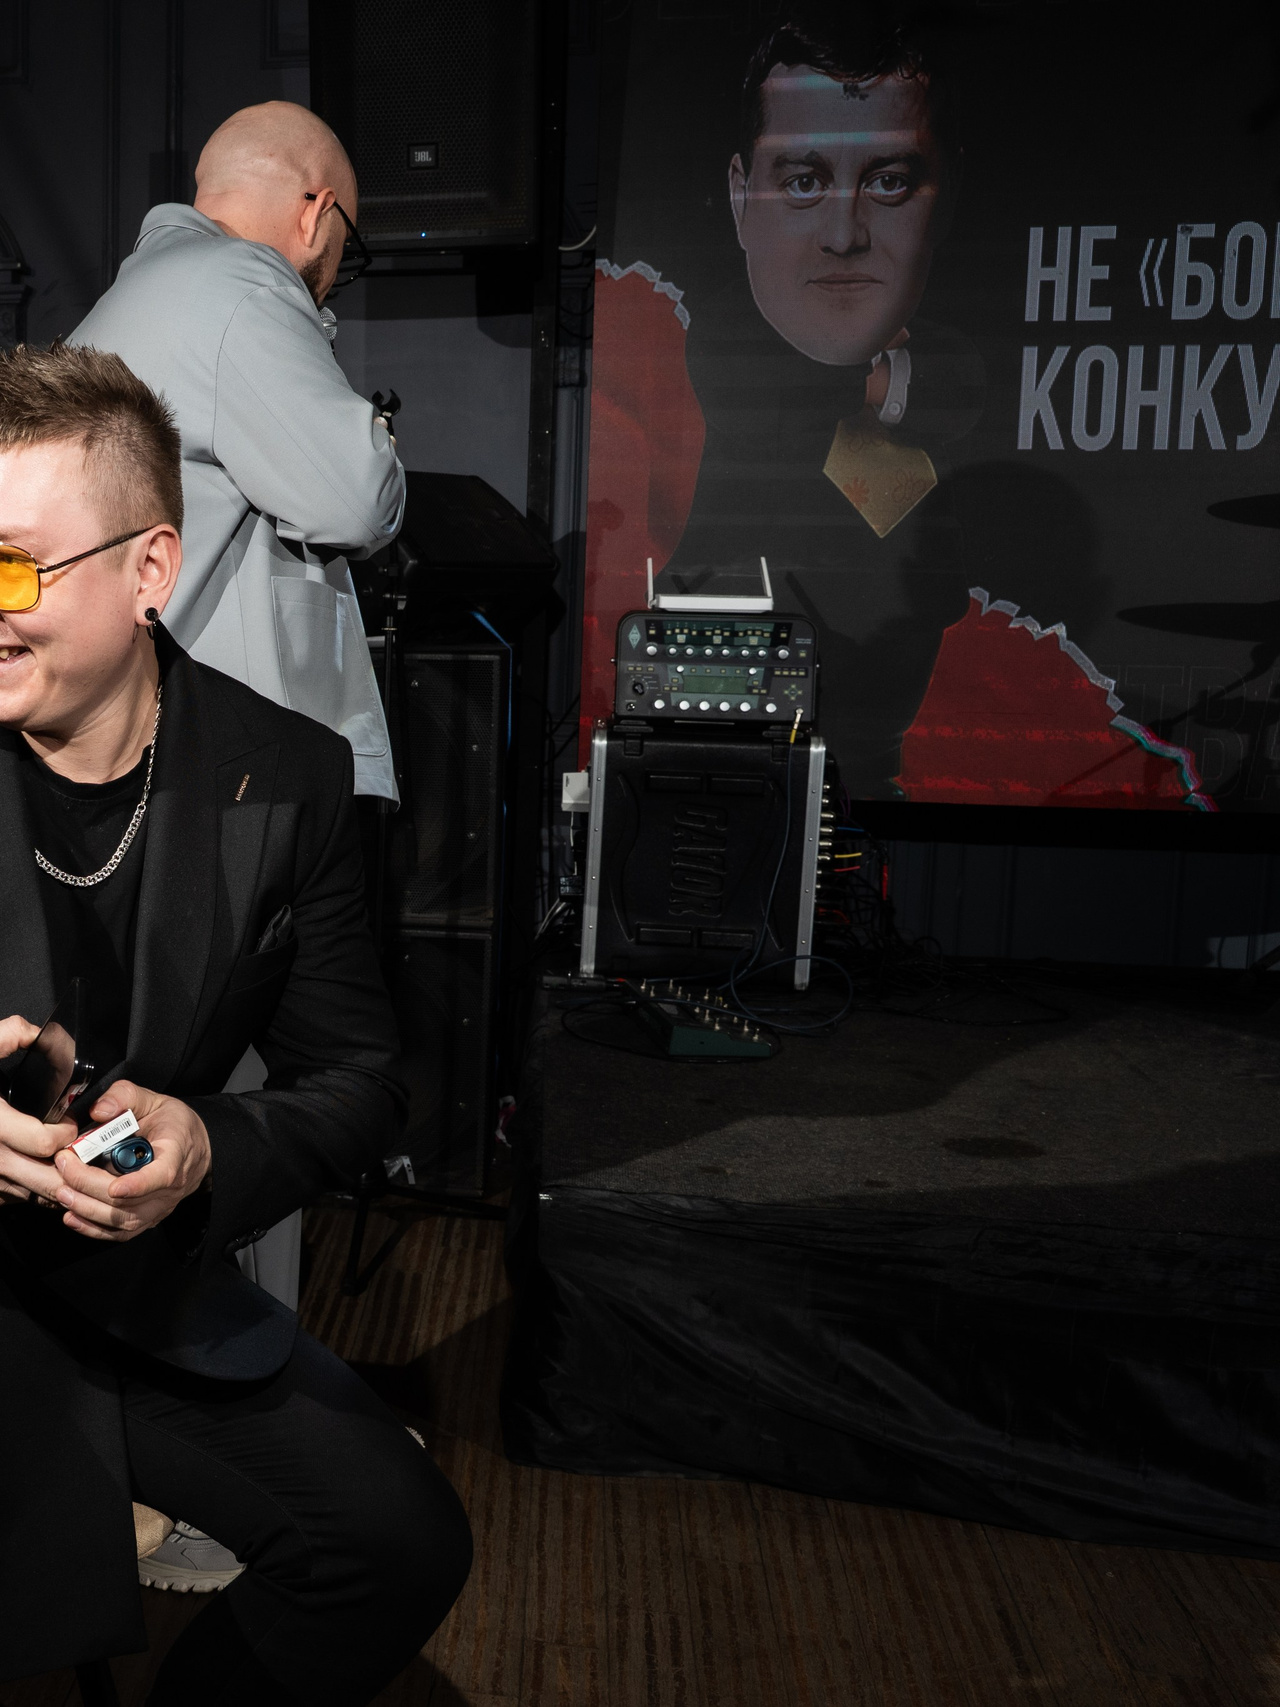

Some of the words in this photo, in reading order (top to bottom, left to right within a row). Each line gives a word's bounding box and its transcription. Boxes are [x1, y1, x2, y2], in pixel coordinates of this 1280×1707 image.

[414, 151, 432, 163] JBL
[1024, 225, 1117, 322] НЕ
[1138, 220, 1280, 321] «БО
[1017, 344, 1280, 452] КОНКУ
[668, 801, 729, 918] GATOR
